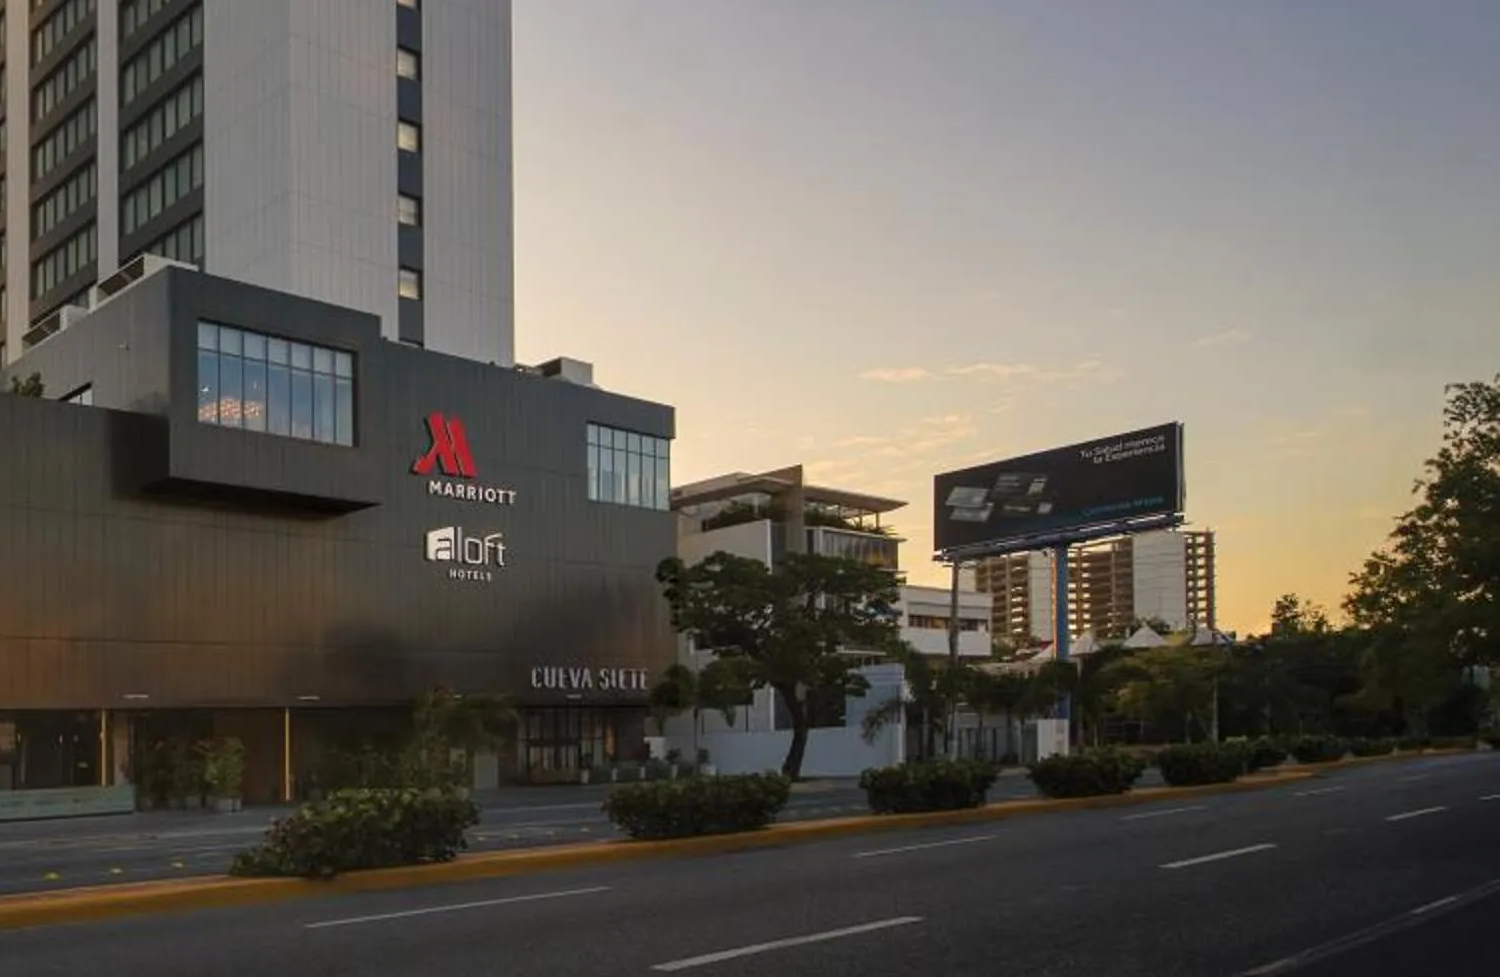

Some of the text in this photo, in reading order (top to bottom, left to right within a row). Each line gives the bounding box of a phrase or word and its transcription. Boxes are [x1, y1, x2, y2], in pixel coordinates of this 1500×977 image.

[428, 480, 517, 505] MARRIOTT
[426, 526, 506, 566] aloft
[449, 568, 492, 582] HOTELS
[531, 667, 649, 690] CUEVA SIETE
